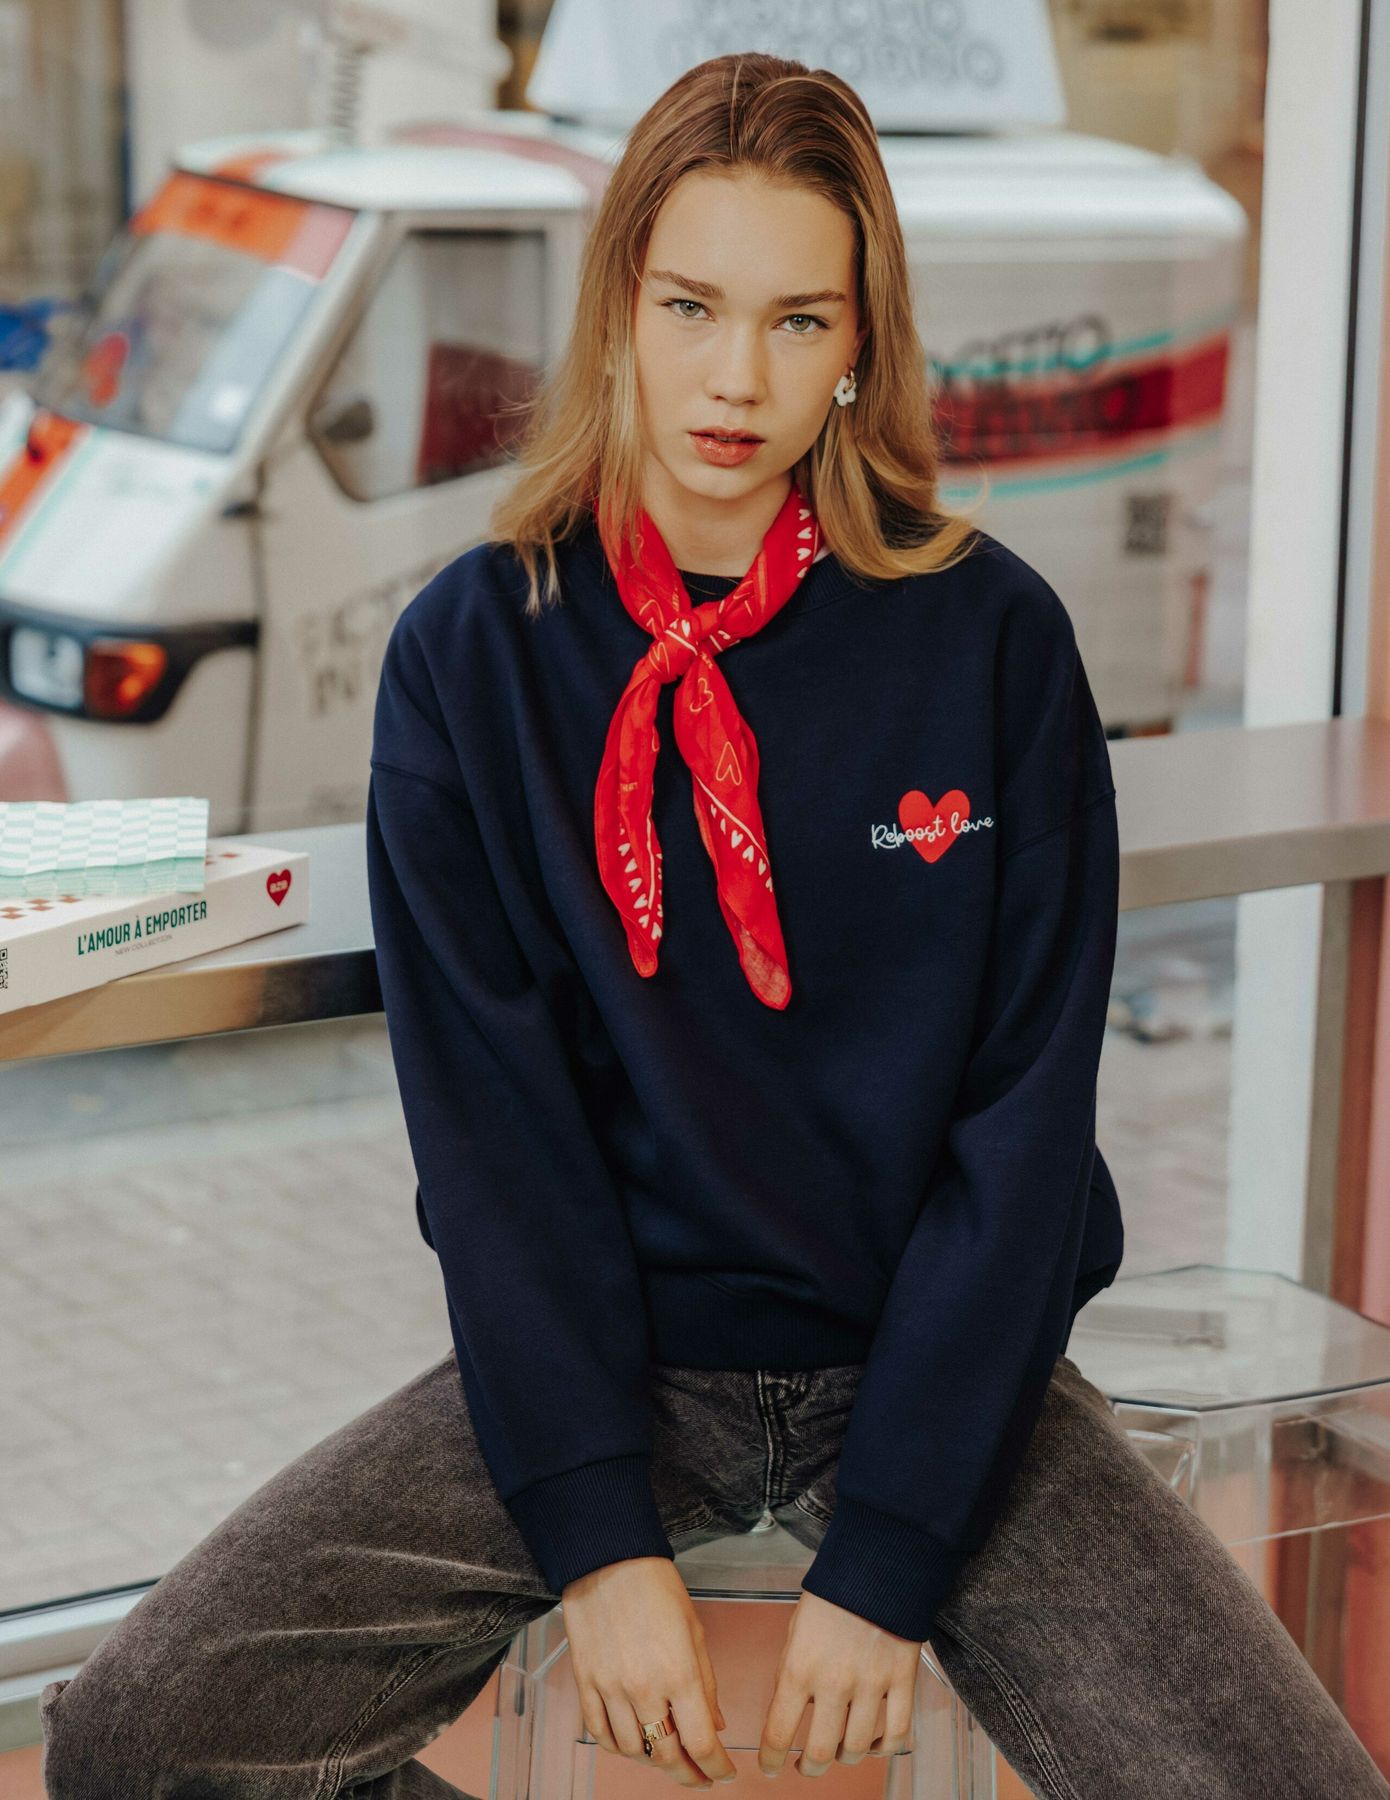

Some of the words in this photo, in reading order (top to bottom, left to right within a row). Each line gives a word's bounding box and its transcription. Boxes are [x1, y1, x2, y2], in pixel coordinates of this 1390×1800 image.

[871, 814, 947, 850] Reboost
[950, 811, 994, 834] love
[78, 922, 131, 956] L'AMOUR
[134, 915, 142, 940] À
[145, 900, 207, 935] EMPORTER
[115, 946, 130, 956] NEW
